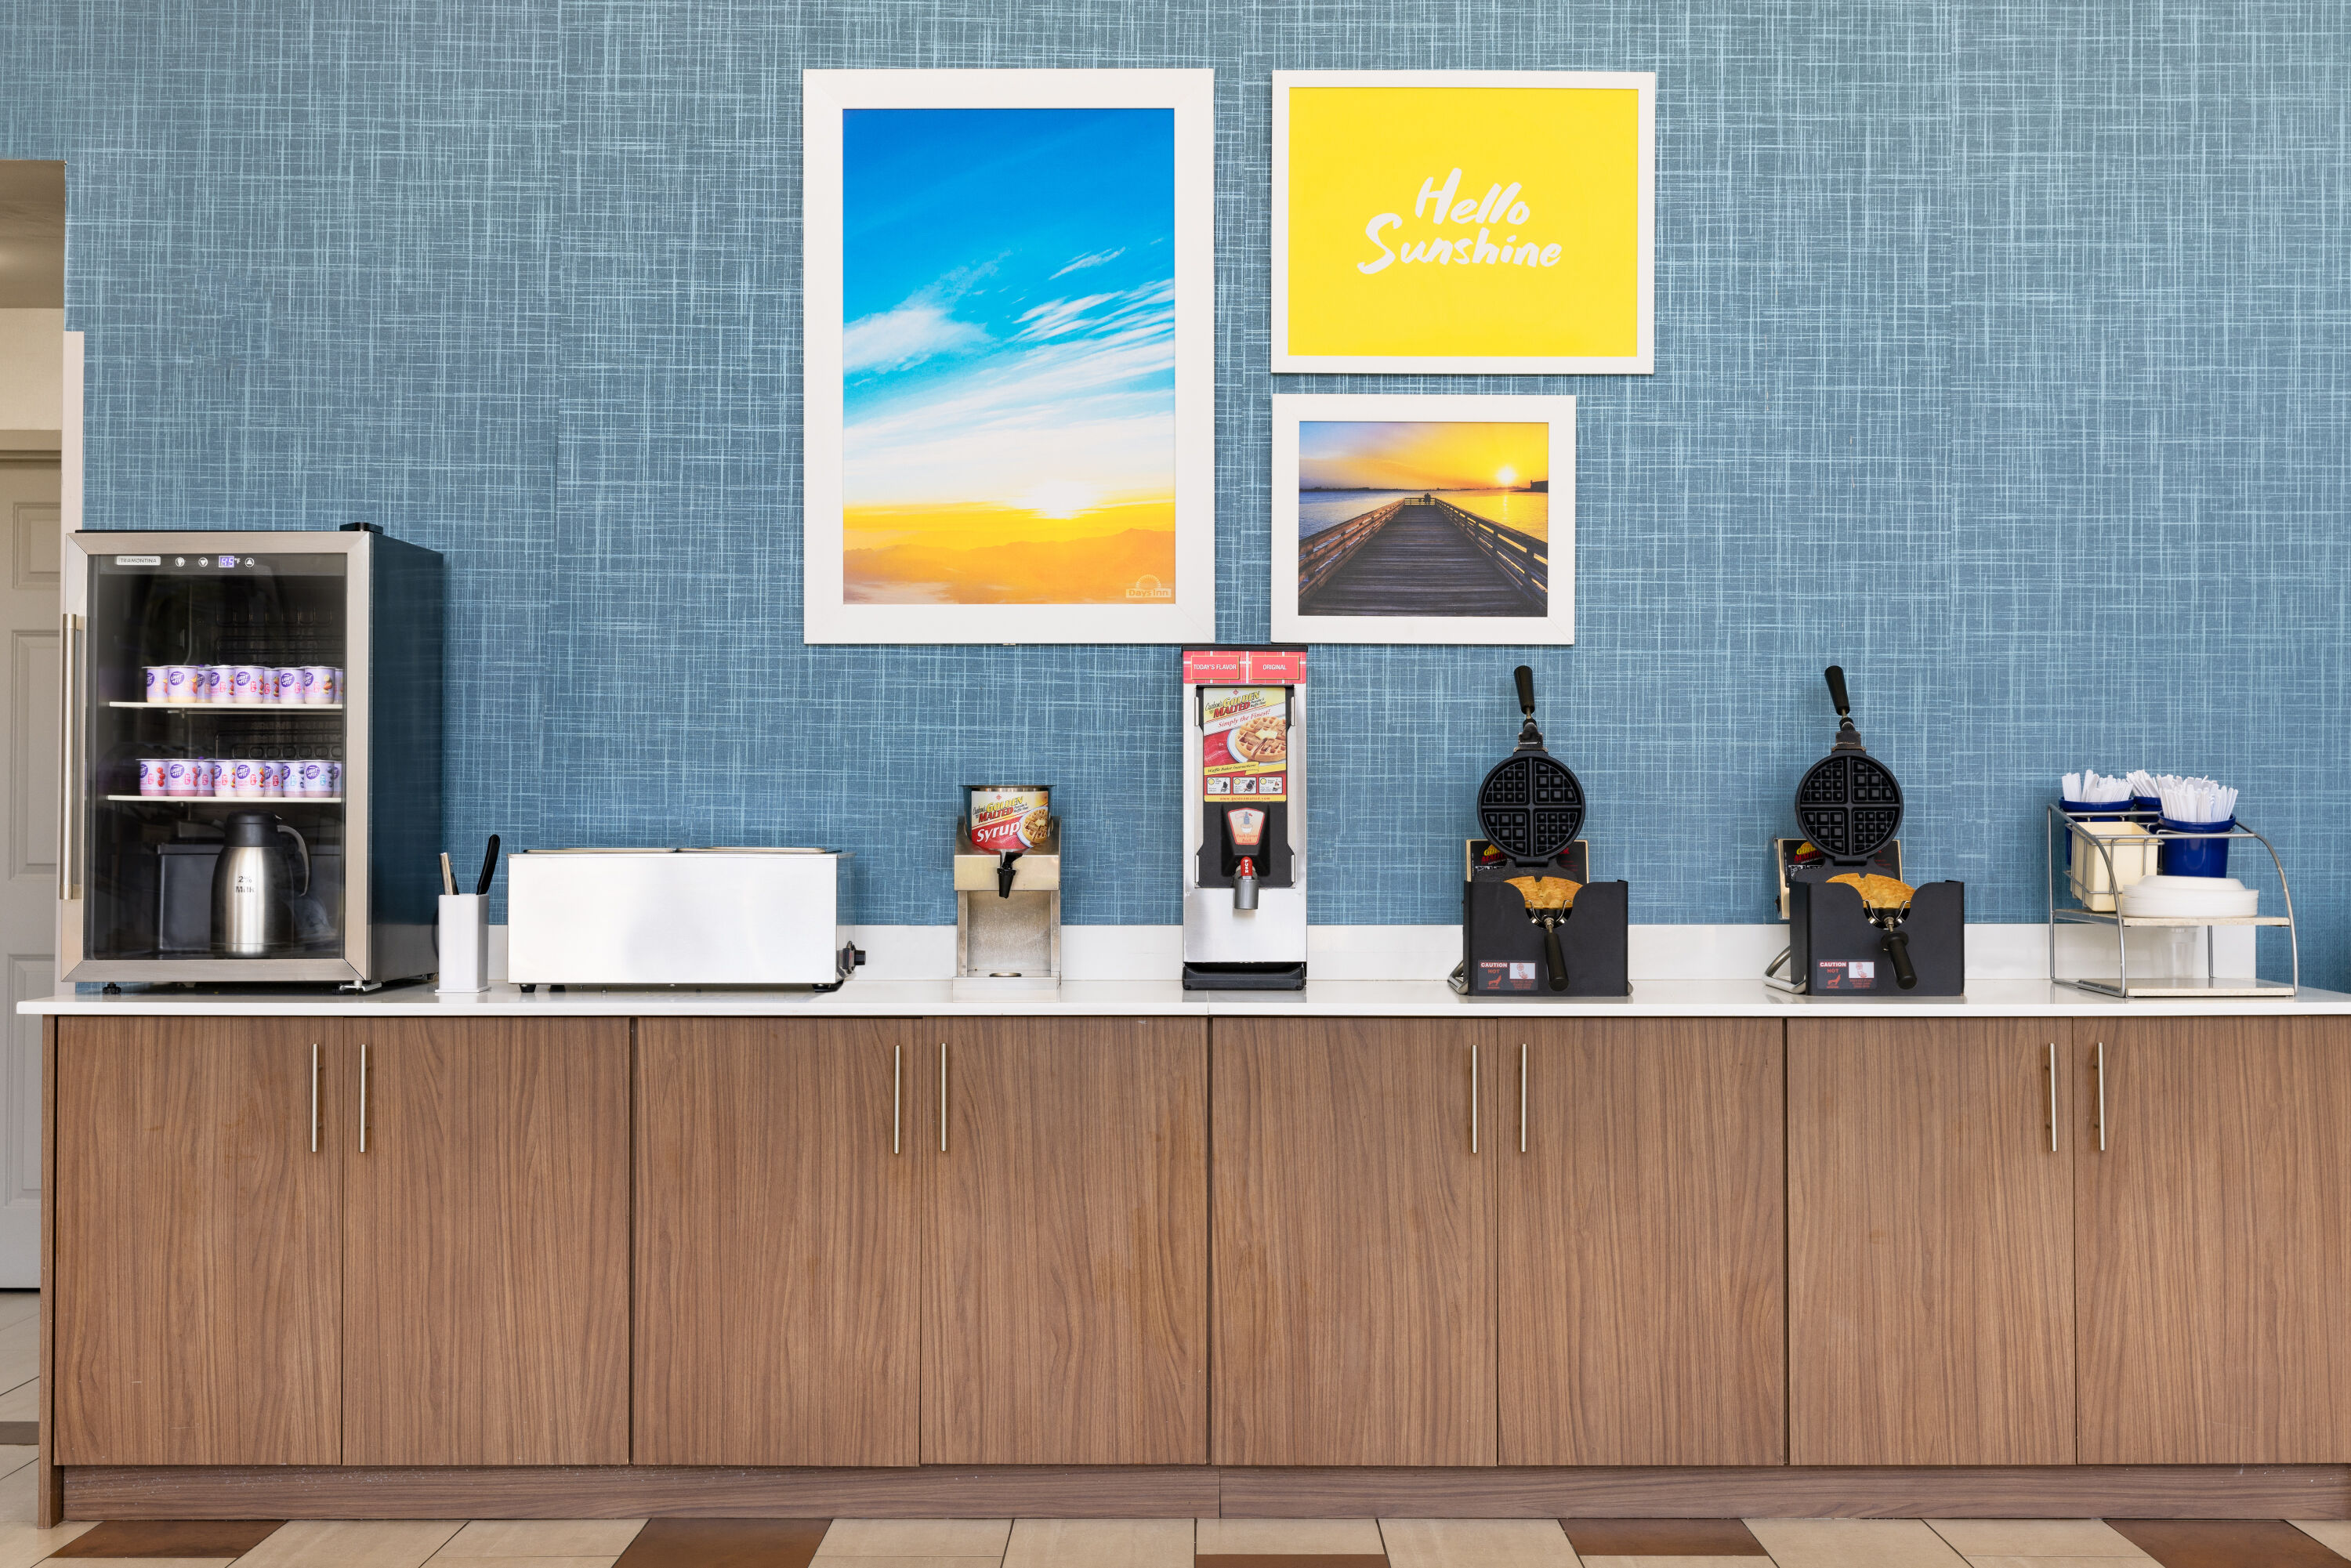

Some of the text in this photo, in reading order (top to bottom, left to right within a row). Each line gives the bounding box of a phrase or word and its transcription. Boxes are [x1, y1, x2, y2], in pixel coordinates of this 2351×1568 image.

[1415, 167, 1531, 225] Hello
[1357, 212, 1563, 274] Sunshine
[1128, 588, 1152, 597] Days
[1223, 691, 1260, 707] GOLDEN
[1213, 701, 1251, 719] MALTED
[1218, 718, 1239, 728] Simply
[1250, 709, 1271, 719] Finest!
[987, 796, 1023, 813] GOLDEN
[978, 806, 1014, 823] MALTED
[976, 821, 1021, 842] Syrup
